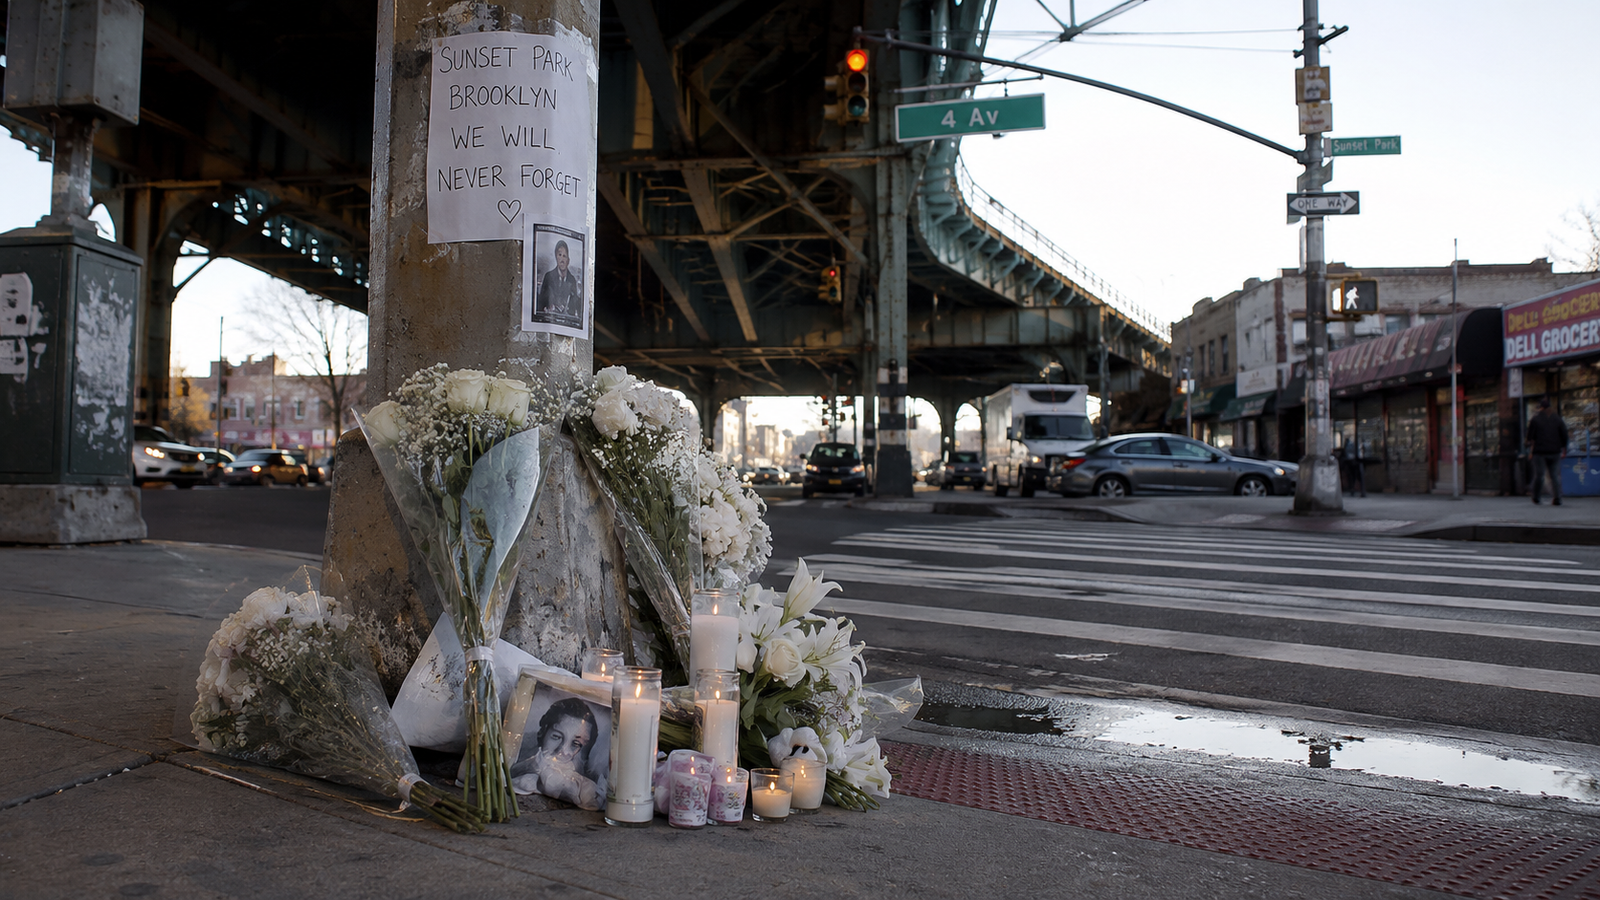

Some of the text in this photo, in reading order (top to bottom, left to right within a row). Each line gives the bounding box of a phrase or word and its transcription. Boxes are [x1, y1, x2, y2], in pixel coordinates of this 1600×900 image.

[439, 45, 574, 82] SUNSET PARK
[449, 84, 557, 110] BROOKLYN
[941, 107, 999, 128] 4 Av
[451, 125, 556, 151] WE WILL
[1333, 138, 1398, 153] Sunset Park
[438, 164, 581, 198] NEVER FORGET
[1297, 198, 1348, 209] ONE WAY
[1506, 318, 1600, 360] DELL GROCER
